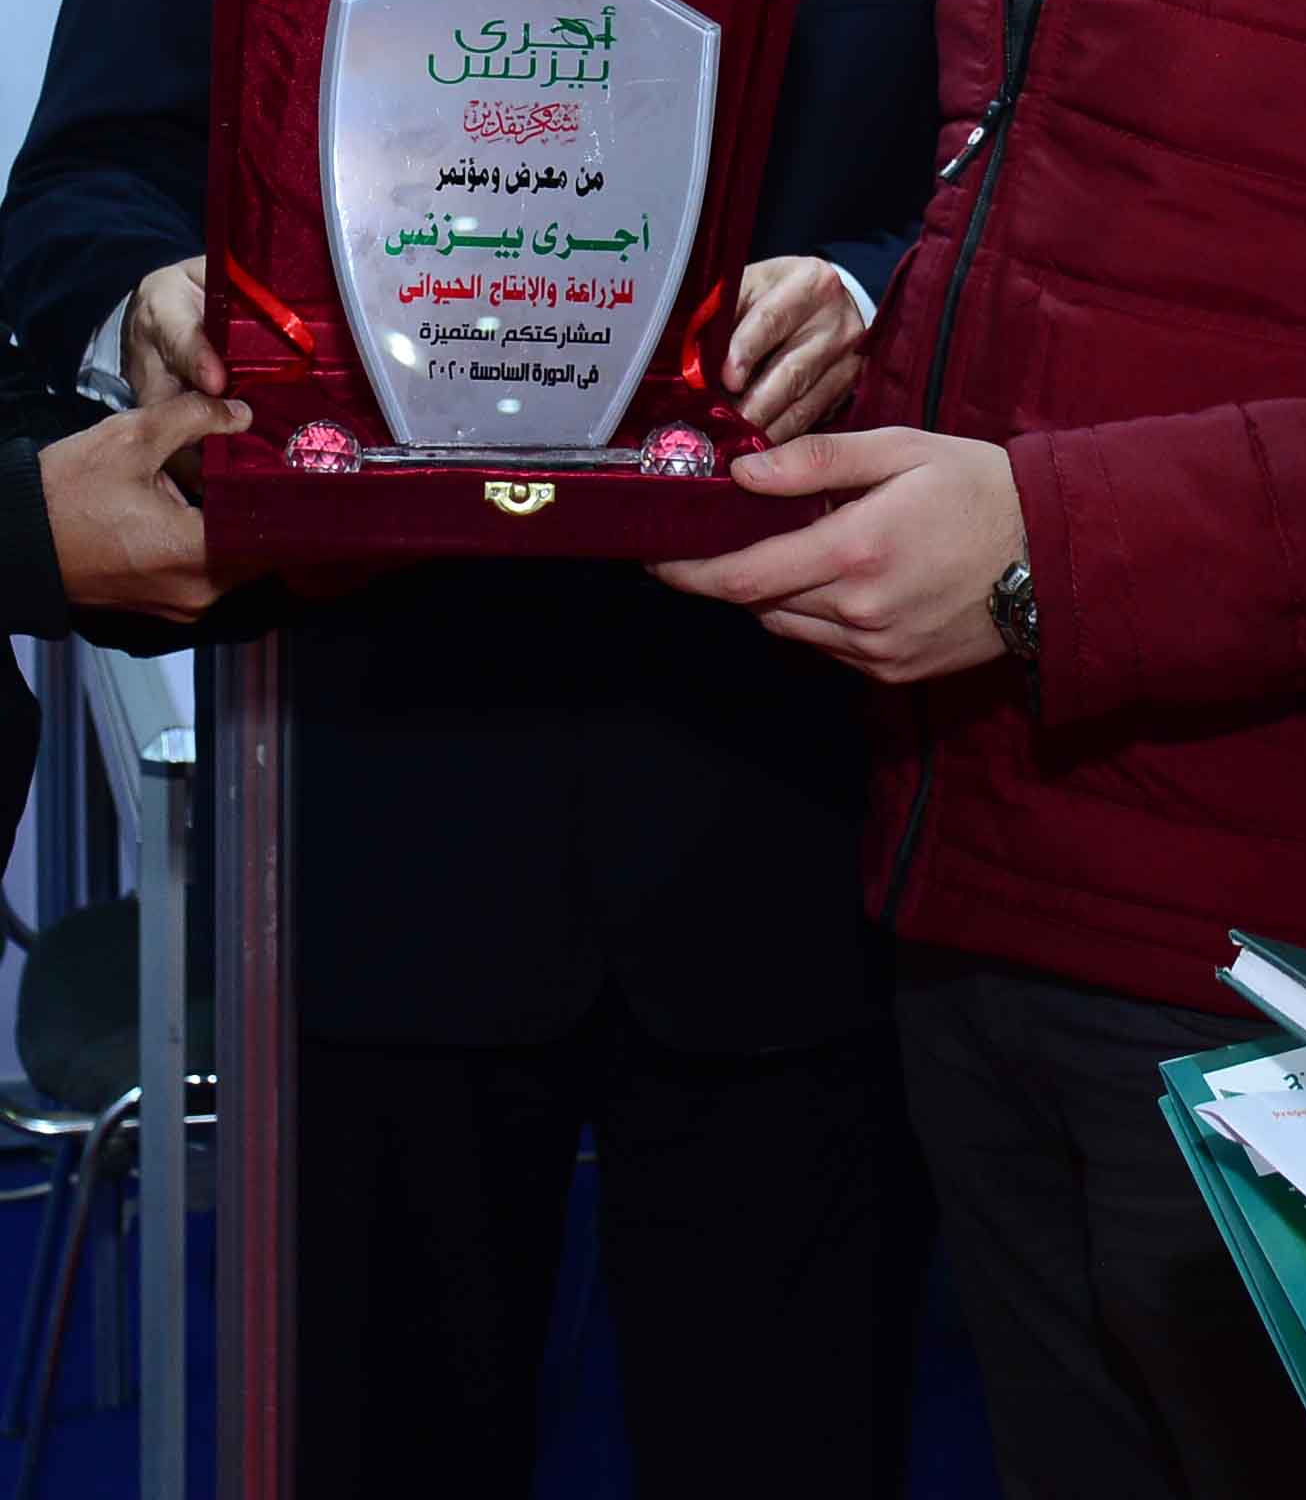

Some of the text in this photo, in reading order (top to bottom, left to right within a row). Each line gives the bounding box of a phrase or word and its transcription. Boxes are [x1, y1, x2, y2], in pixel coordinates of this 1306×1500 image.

[428, 51, 610, 91] بيزنس
[434, 157, 605, 197] من معرض ومؤتمر
[384, 211, 652, 263] أجرى بيزنس
[489, 274, 559, 309] والإنتاج
[565, 275, 635, 310] للزراعة
[418, 321, 612, 349] لمشاركتكم المتميزة
[427, 359, 466, 381] ٢٠٢٠
[469, 361, 530, 384] السادسة
[531, 362, 575, 388] الدورة
